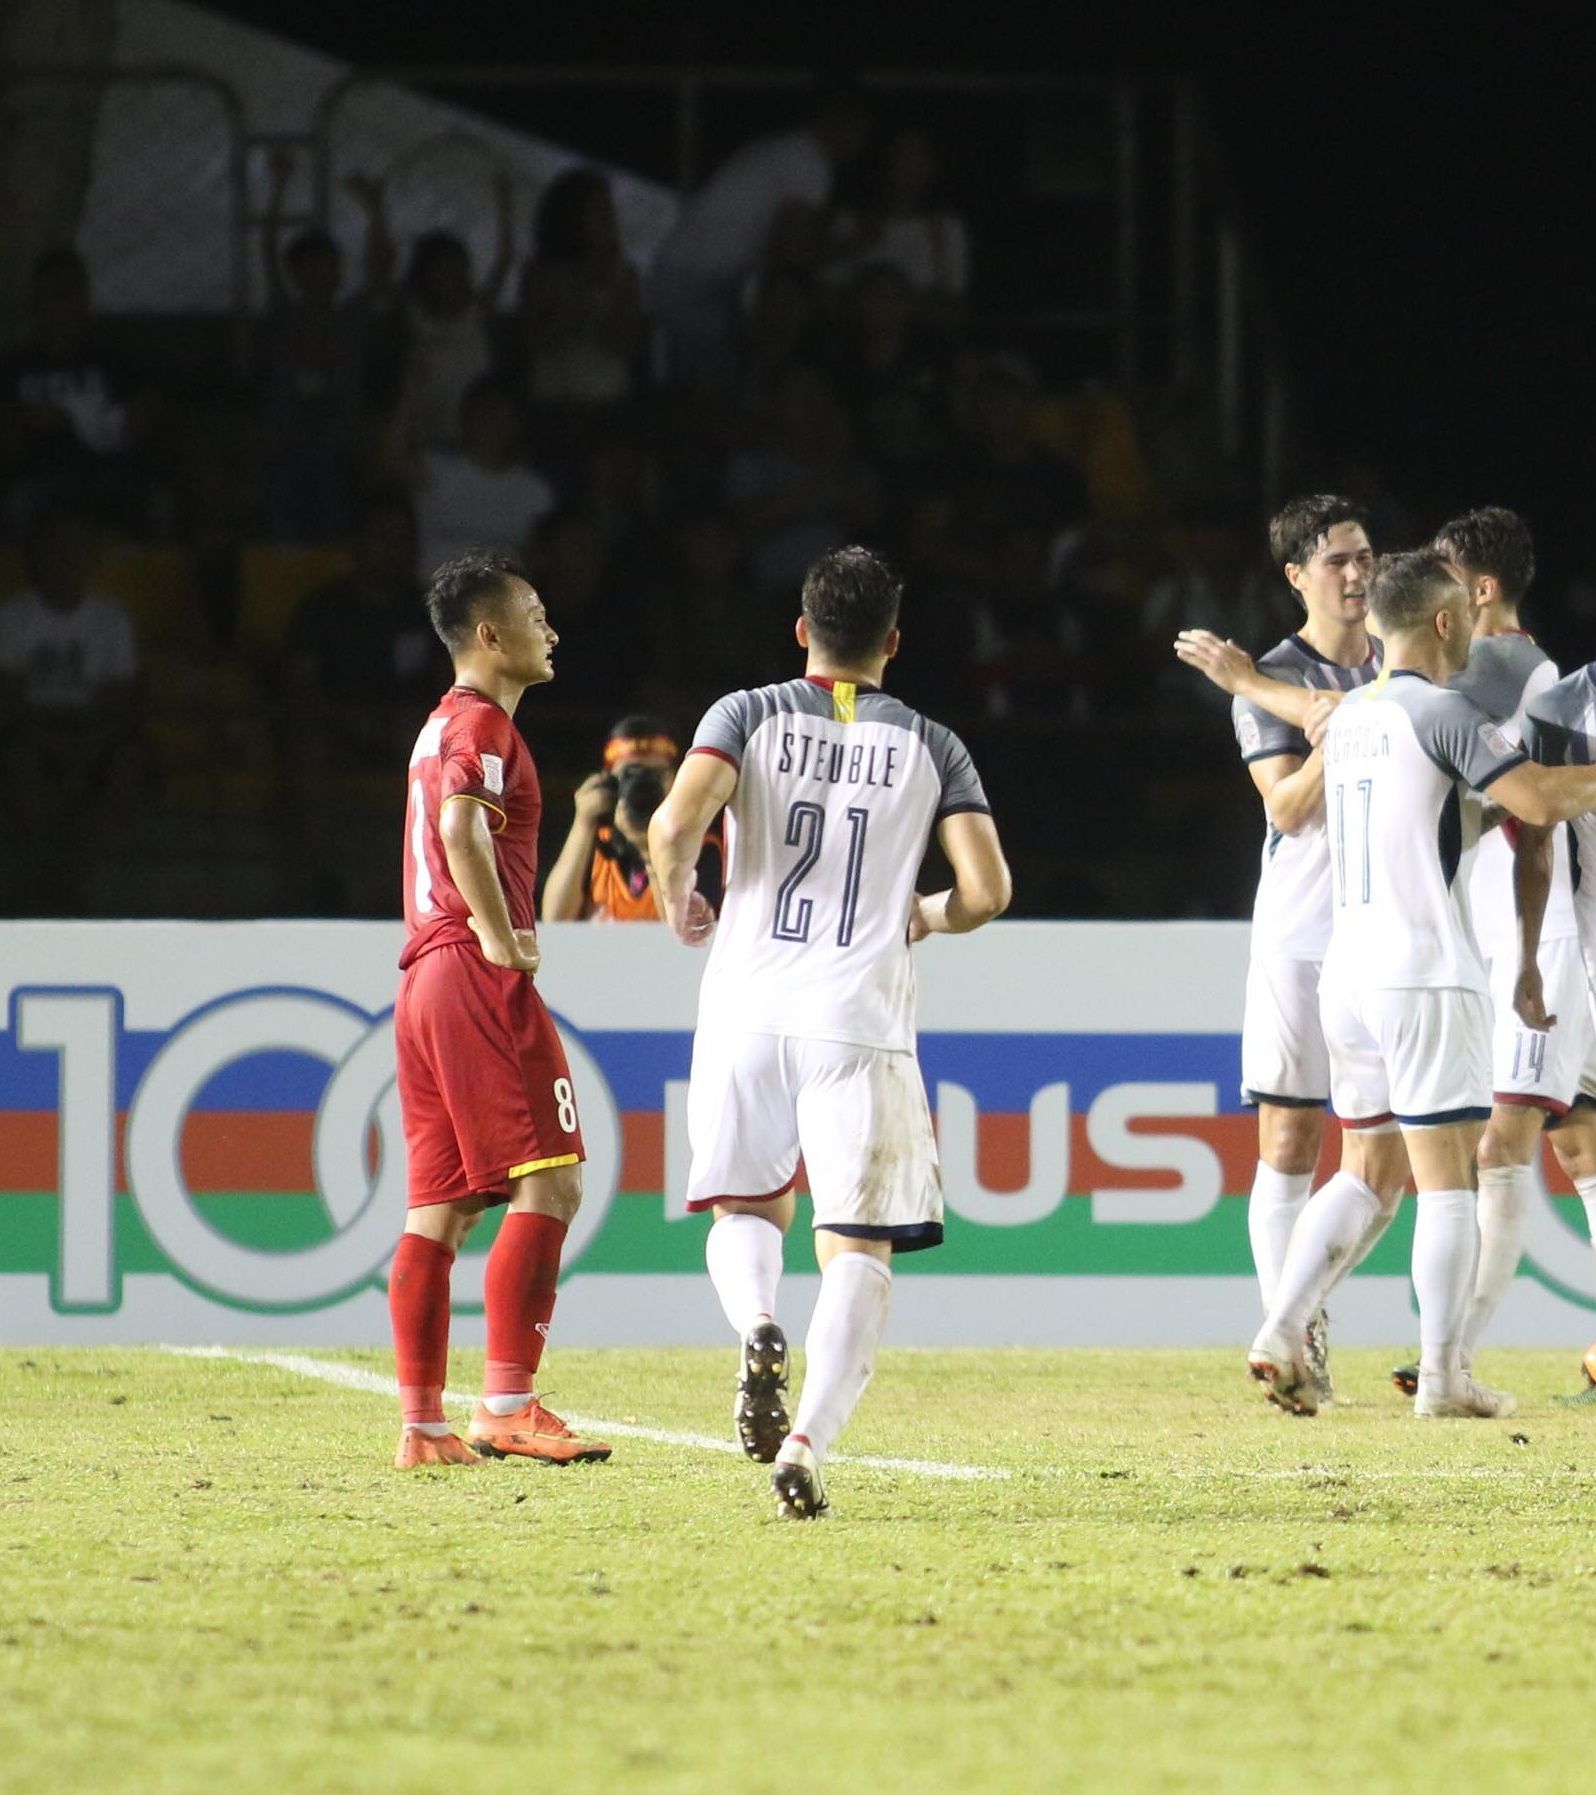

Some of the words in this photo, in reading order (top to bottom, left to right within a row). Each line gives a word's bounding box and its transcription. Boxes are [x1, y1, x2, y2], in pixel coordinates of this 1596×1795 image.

[779, 732, 897, 788] STEUBLE
[772, 801, 869, 947] 21
[1512, 1031, 1547, 1083] 14
[553, 1077, 577, 1133] 8
